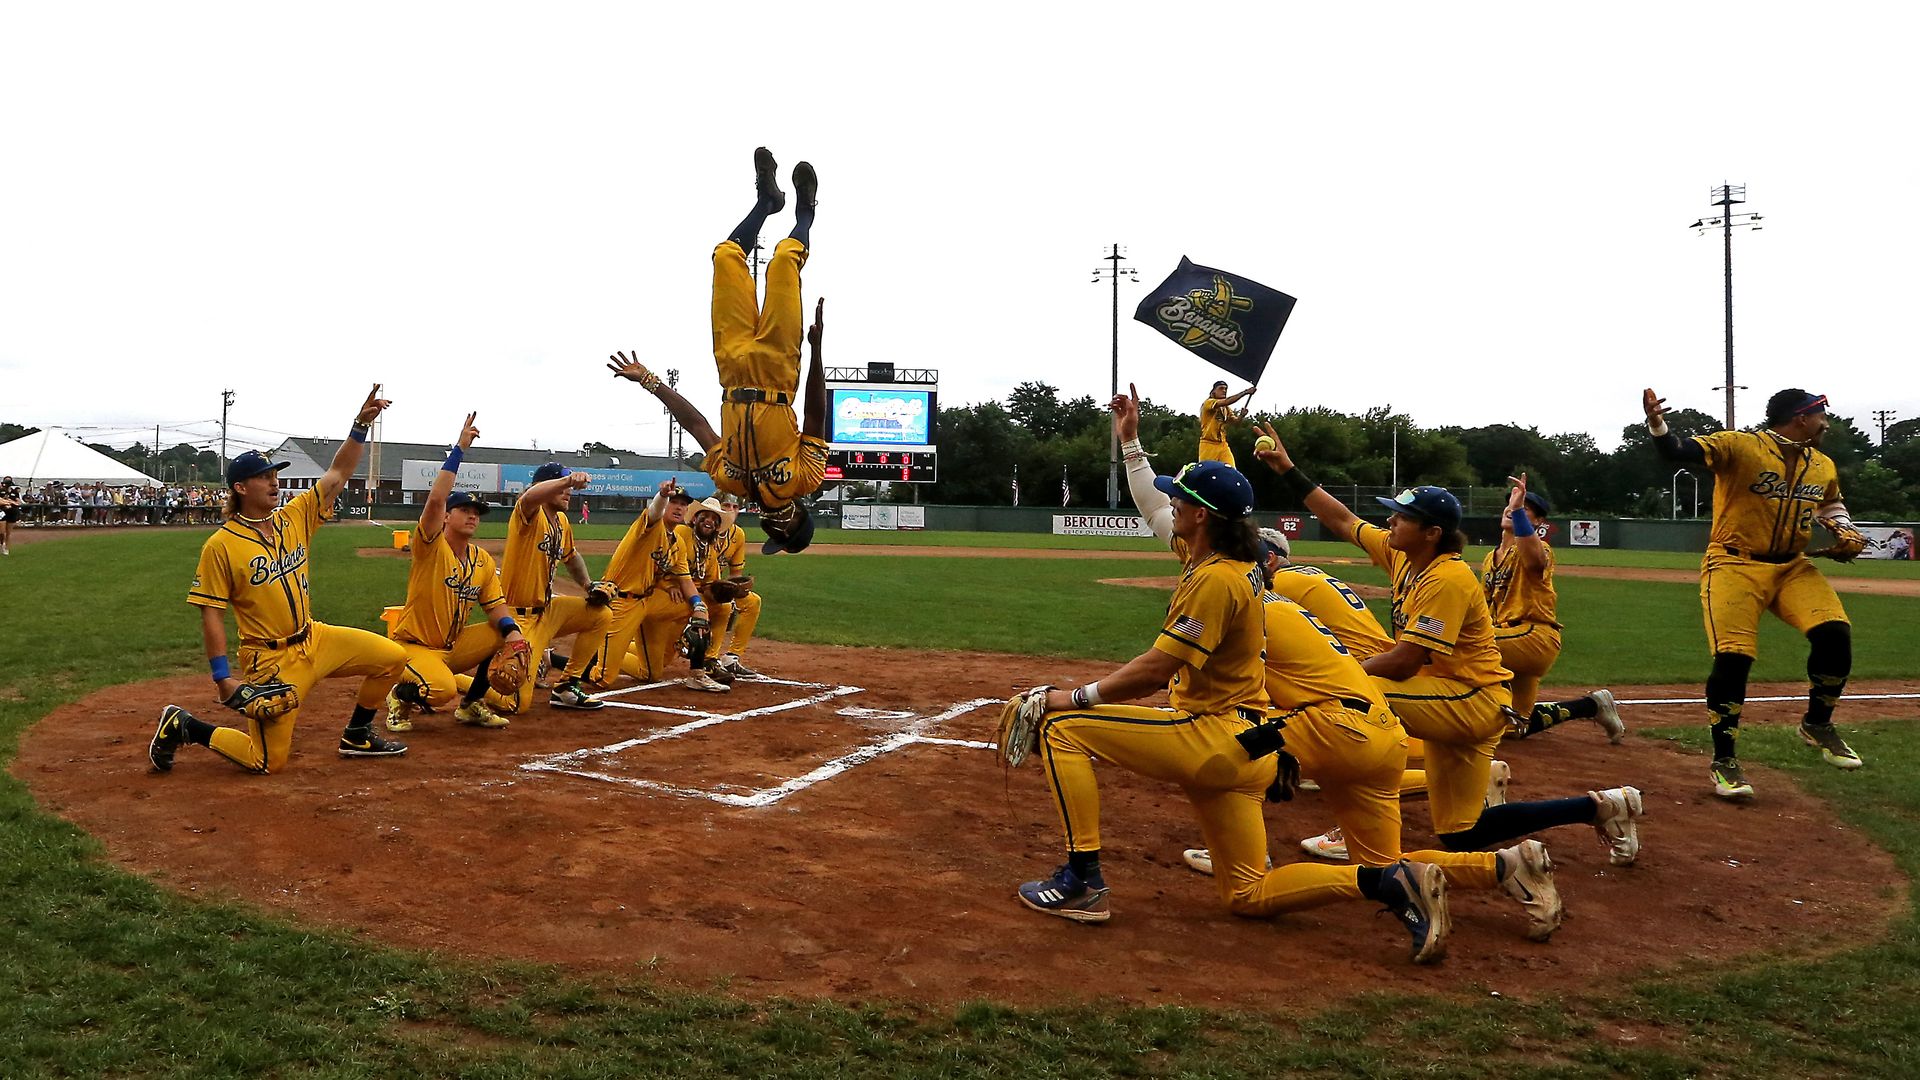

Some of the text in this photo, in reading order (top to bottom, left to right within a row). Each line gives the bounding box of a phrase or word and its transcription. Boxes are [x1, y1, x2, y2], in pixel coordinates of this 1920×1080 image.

[1159, 297, 1239, 351] Bananas
[606, 483, 652, 493] Assessment
[350, 506, 367, 515] 320
[1063, 516, 1139, 529] BERTUCCI'S
[1283, 522, 1297, 531] 62
[1324, 577, 1366, 611] 6
[1298, 609, 1350, 656] 5
